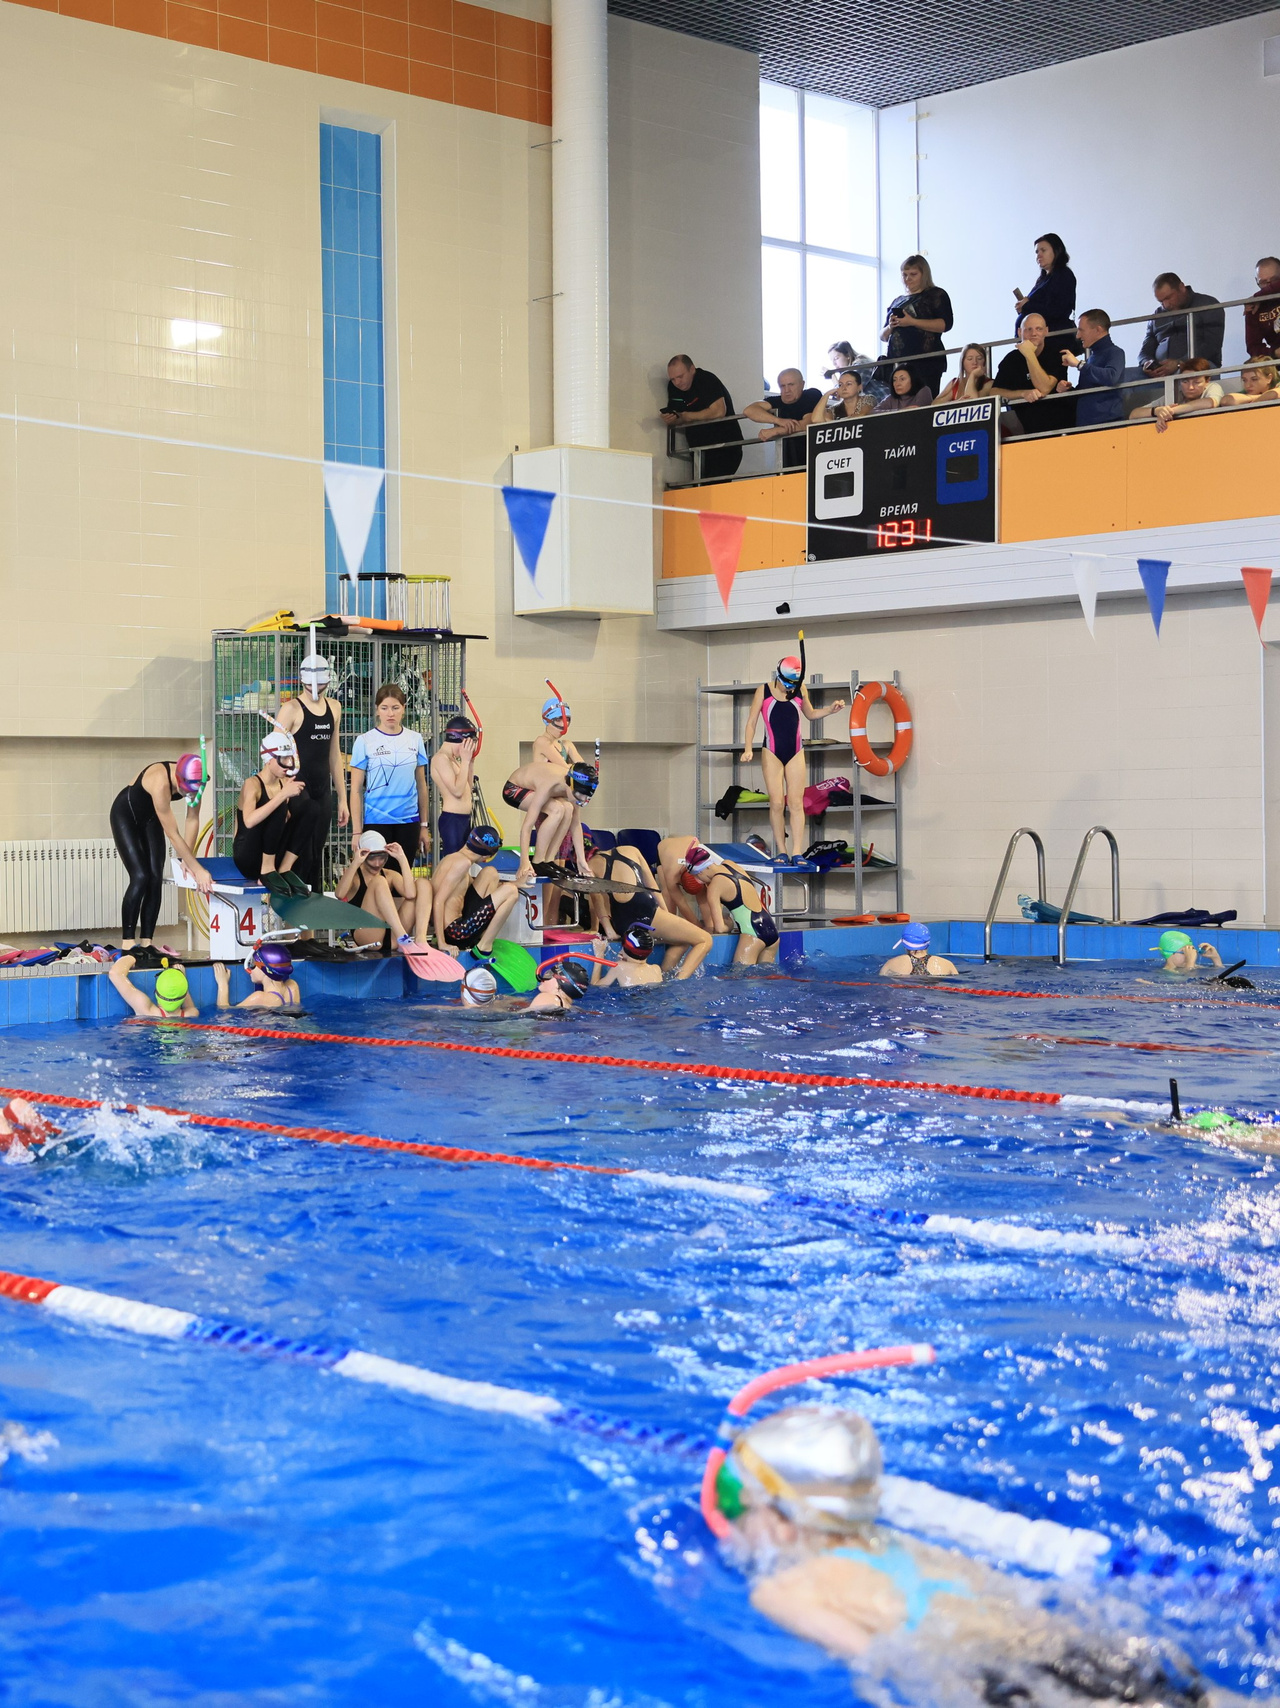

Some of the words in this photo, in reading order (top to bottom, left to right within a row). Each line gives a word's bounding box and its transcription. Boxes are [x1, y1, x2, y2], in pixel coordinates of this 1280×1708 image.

[815, 424, 864, 445] БЕЛЫЕ
[935, 404, 990, 426] СИНИЕ
[827, 457, 852, 470] СЧЕТ
[884, 445, 916, 459] ТАЙМ
[949, 439, 976, 453] СЧЕТ
[879, 502, 919, 517] ВРЕМЯ
[210, 914, 220, 933] 4
[240, 907, 256, 935] 4
[525, 895, 539, 921] 5
